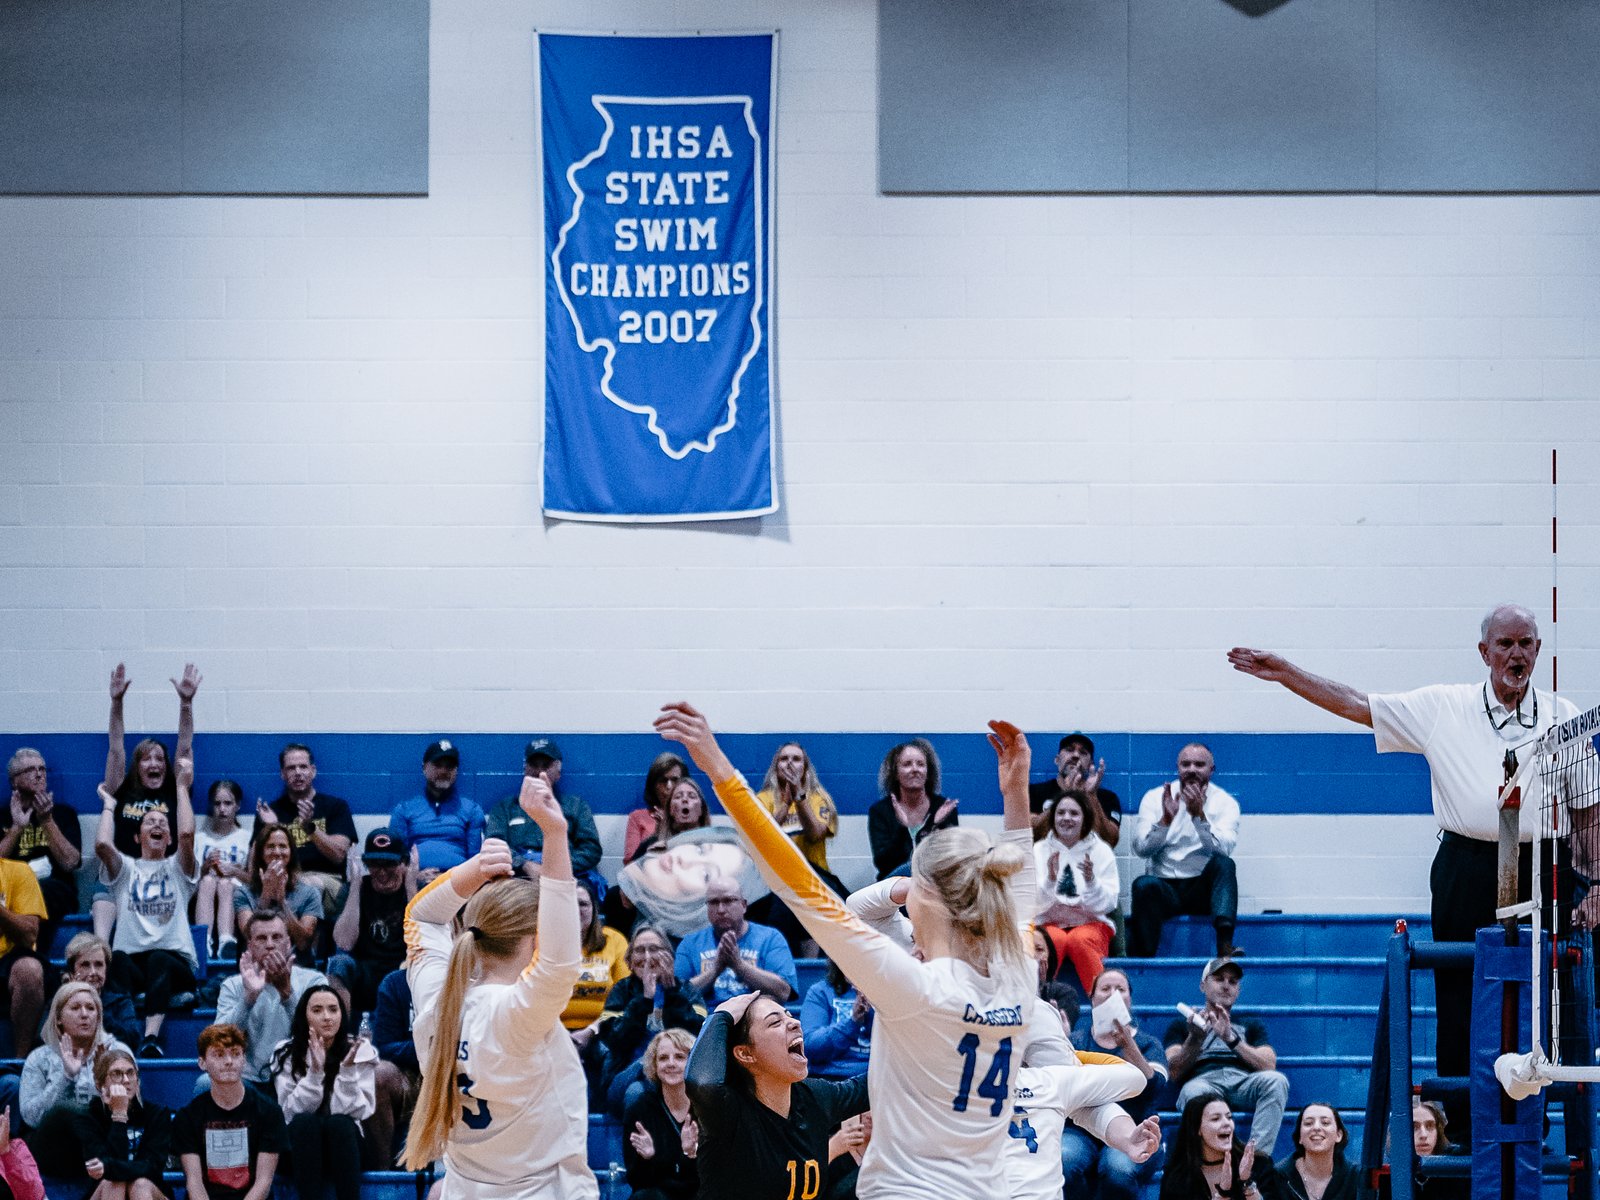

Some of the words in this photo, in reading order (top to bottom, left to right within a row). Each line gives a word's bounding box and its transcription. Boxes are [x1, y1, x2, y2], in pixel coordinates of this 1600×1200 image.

[630, 125, 733, 159] IHSA
[605, 170, 729, 205] STATE
[614, 217, 717, 252] SWIM
[570, 261, 750, 298] CHAMPIONS
[618, 308, 718, 344] 2007
[953, 1032, 1012, 1118] 14
